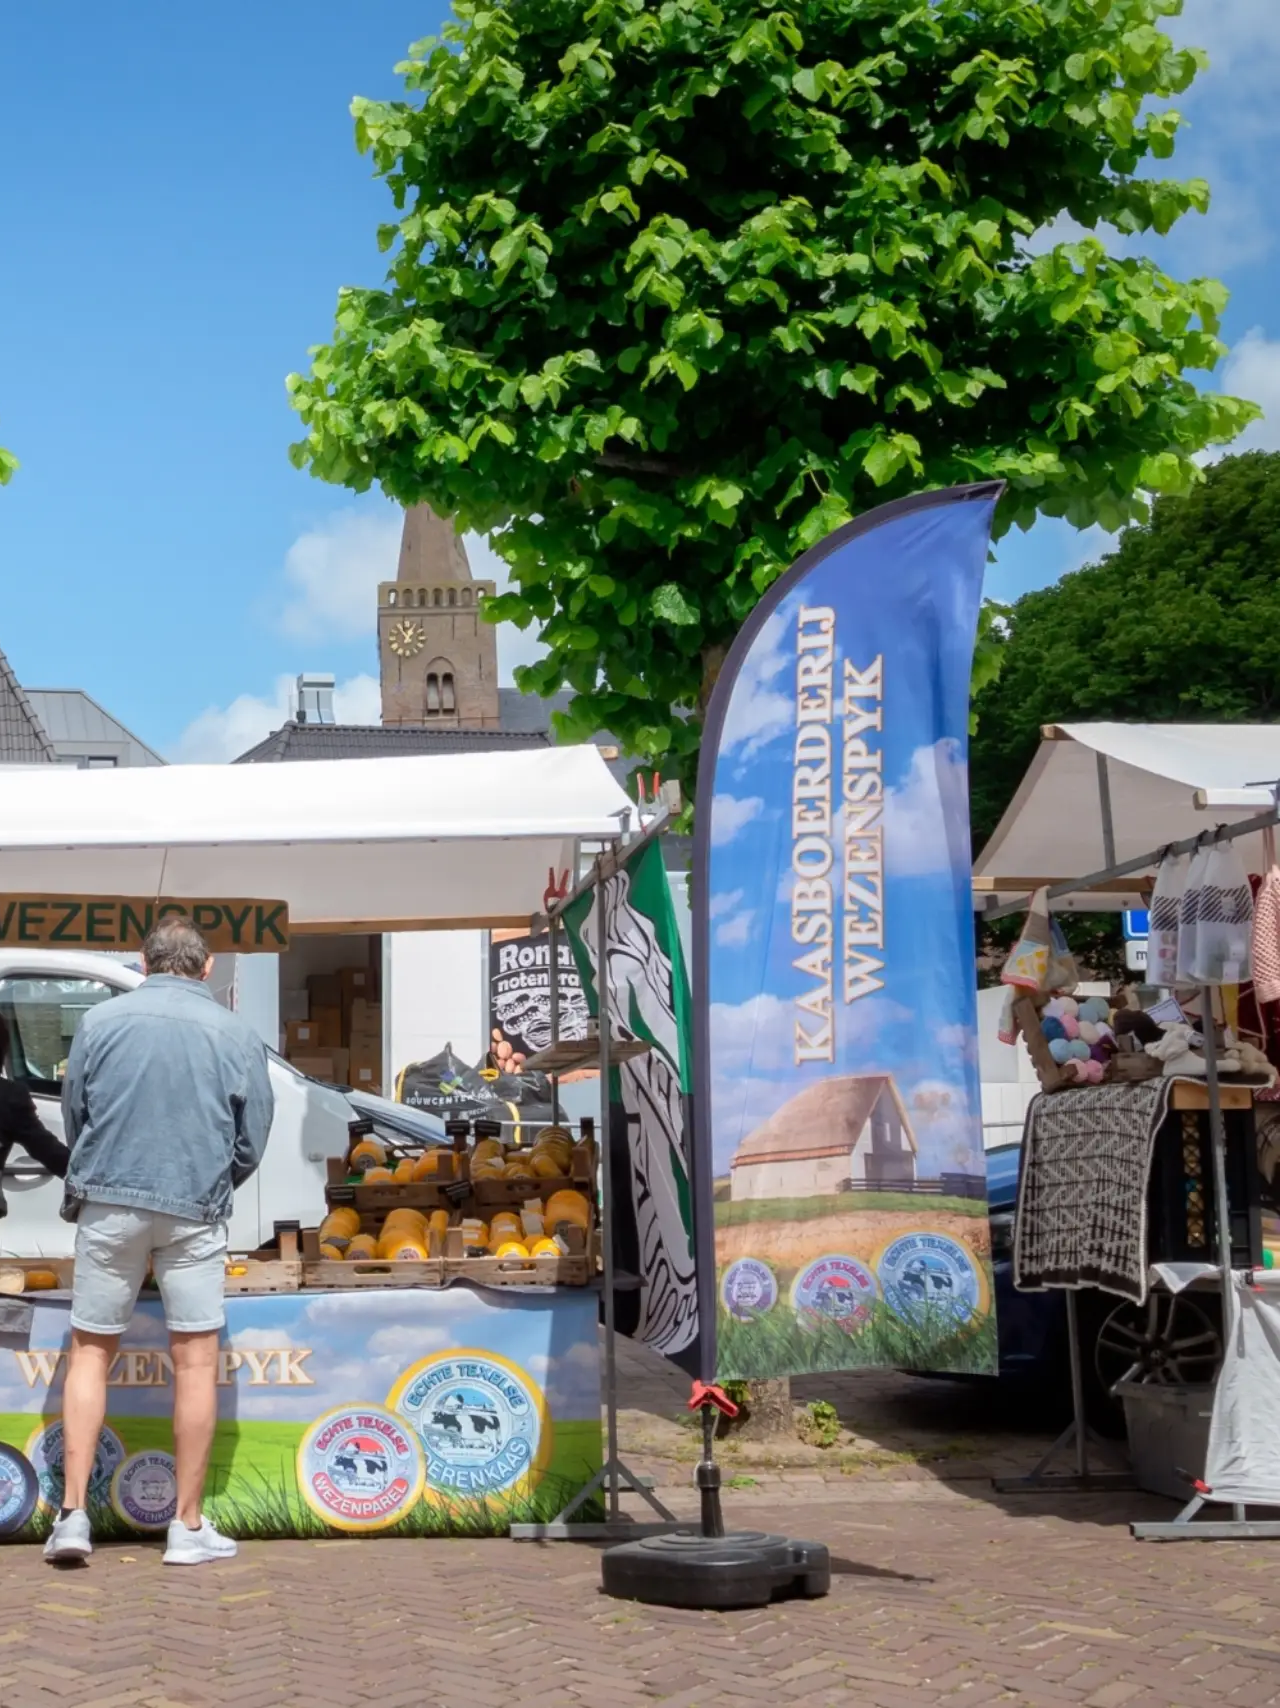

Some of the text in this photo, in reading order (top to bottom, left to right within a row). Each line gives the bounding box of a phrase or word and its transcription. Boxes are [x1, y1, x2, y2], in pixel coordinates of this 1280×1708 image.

[791, 604, 836, 1066] KAASBOERDERIJ
[843, 653, 885, 1005] WEZENSPYK
[407, 1363, 526, 1410] ECHTE TEXELSE
[315, 1416, 410, 1456] ECHTE TEXELSE
[315, 1475, 407, 1516] WEZENPAREL
